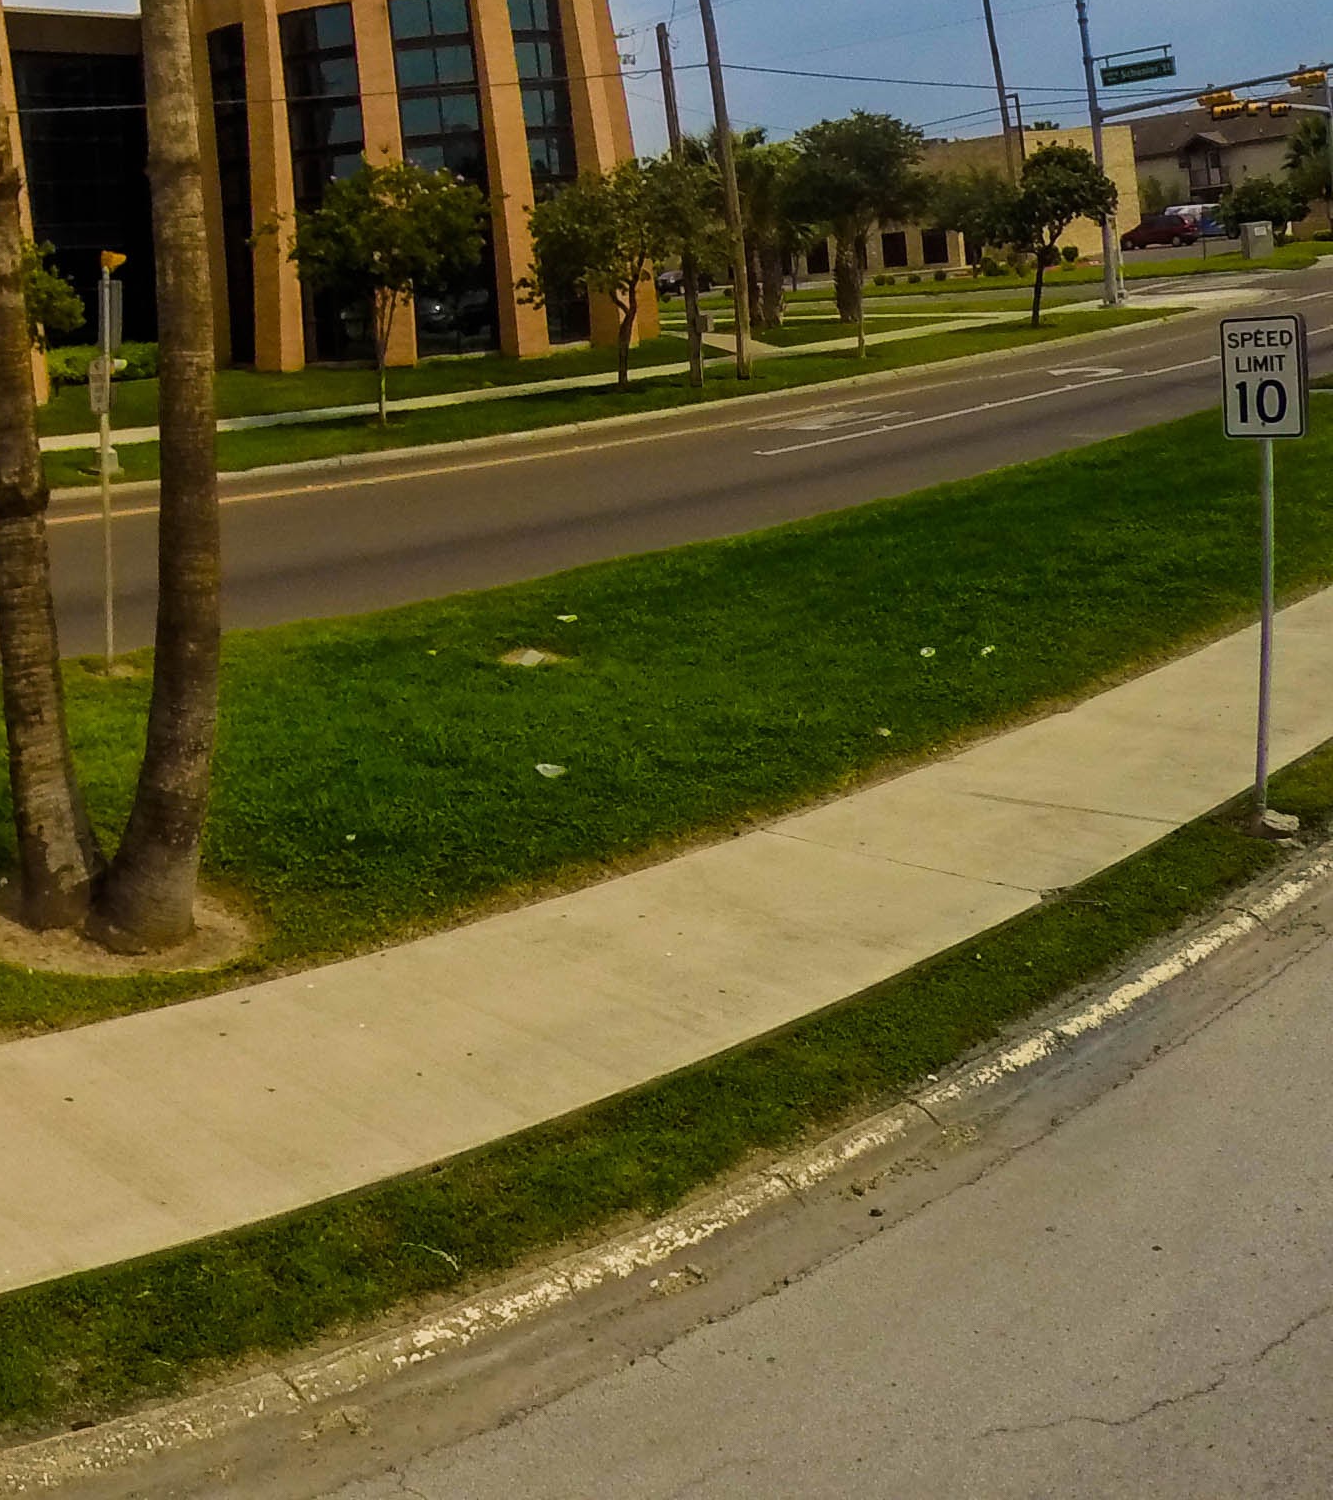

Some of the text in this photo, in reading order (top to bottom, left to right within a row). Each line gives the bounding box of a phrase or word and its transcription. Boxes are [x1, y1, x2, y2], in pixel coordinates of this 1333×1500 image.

[1227, 329, 1293, 349] SPEED
[1235, 355, 1285, 373] LIMIT
[1235, 379, 1287, 423] 10
